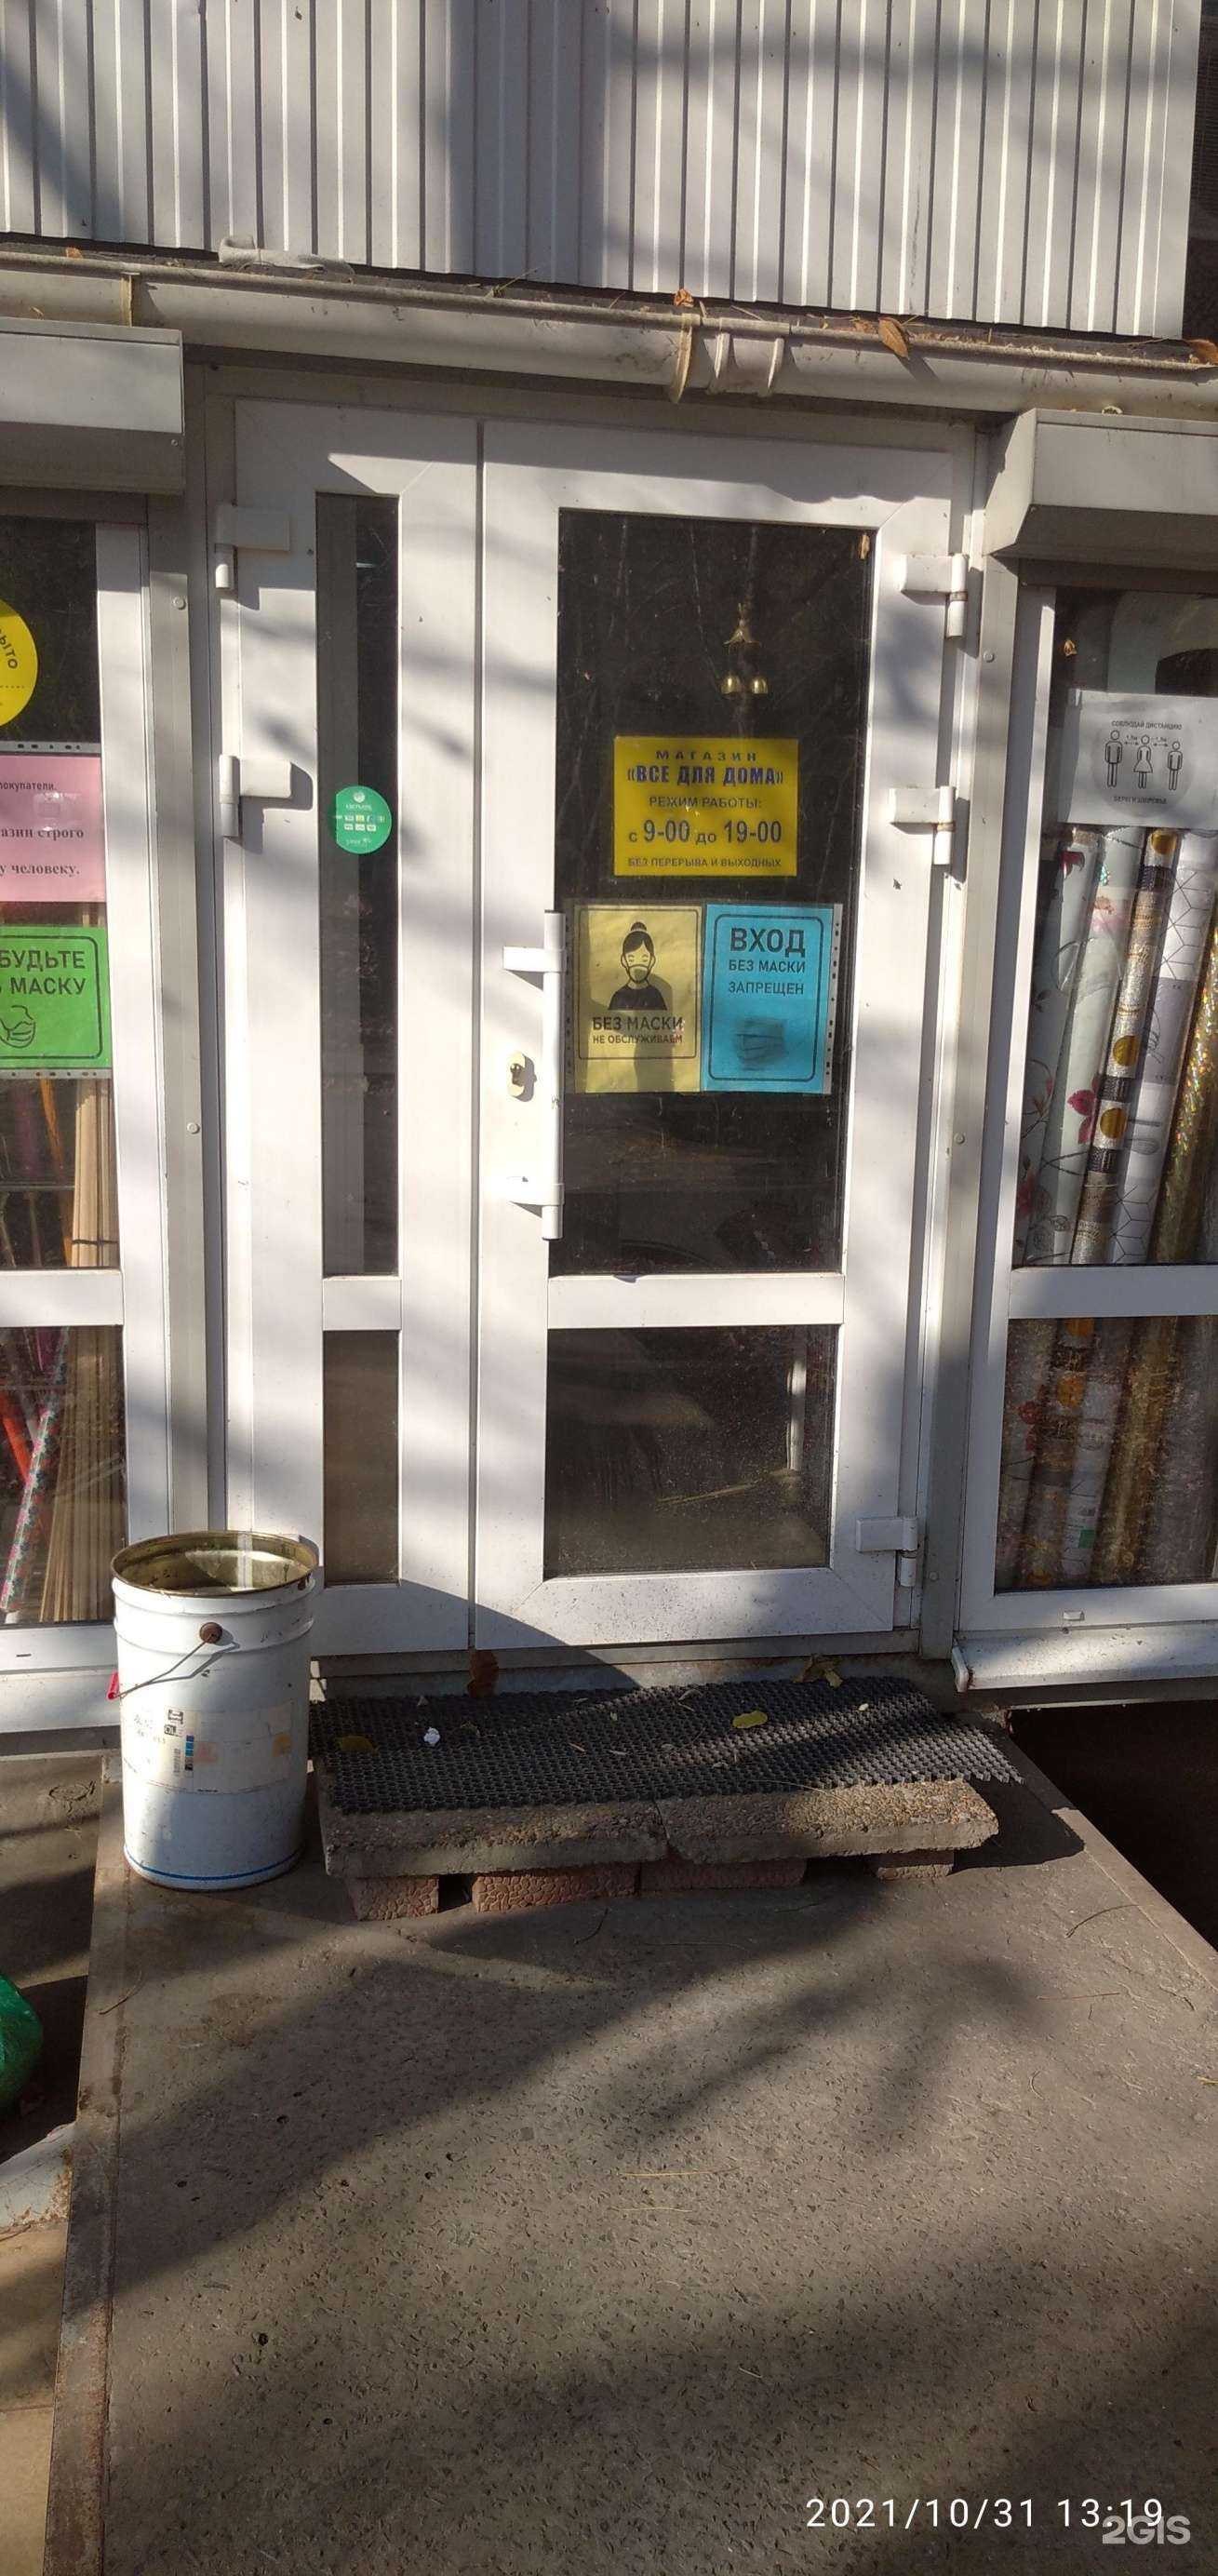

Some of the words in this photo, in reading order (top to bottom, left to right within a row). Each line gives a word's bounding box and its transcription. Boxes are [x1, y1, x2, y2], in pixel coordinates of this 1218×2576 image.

[0, 628, 18, 669] ЫТО
[655, 750, 756, 762] МАГАЗИН
[677, 766, 715, 786] ДЛЯ
[649, 796, 698, 808] РЕЖИМ
[702, 797, 762, 809] РАБОТЫ:
[37, 828, 85, 841] строго
[643, 819, 690, 843] 9-00
[695, 832, 716, 846] до
[723, 820, 782, 843] 19-00
[628, 857, 649, 867] БЕЗ
[651, 857, 707, 868] ПЕРЕРЫВА
[711, 858, 718, 867] И
[721, 858, 782, 868] ВЫХОДНЫХ
[11, 865, 80, 878] человеку.
[729, 927, 806, 958] ВХОД
[0, 949, 86, 972] БУДЬТЕ
[729, 959, 754, 972] БЕЗ
[758, 959, 805, 973] МАСКИ
[10, 977, 87, 995] МАСКУ
[728, 981, 804, 997] ЗАПРЕЩЕН
[592, 1016, 622, 1031] БЕЗ
[626, 1016, 684, 1031] МАСКИ
[593, 1035, 606, 1044] НЕ
[608, 1034, 683, 1044] ОБСЛУЖИВАЕМ
